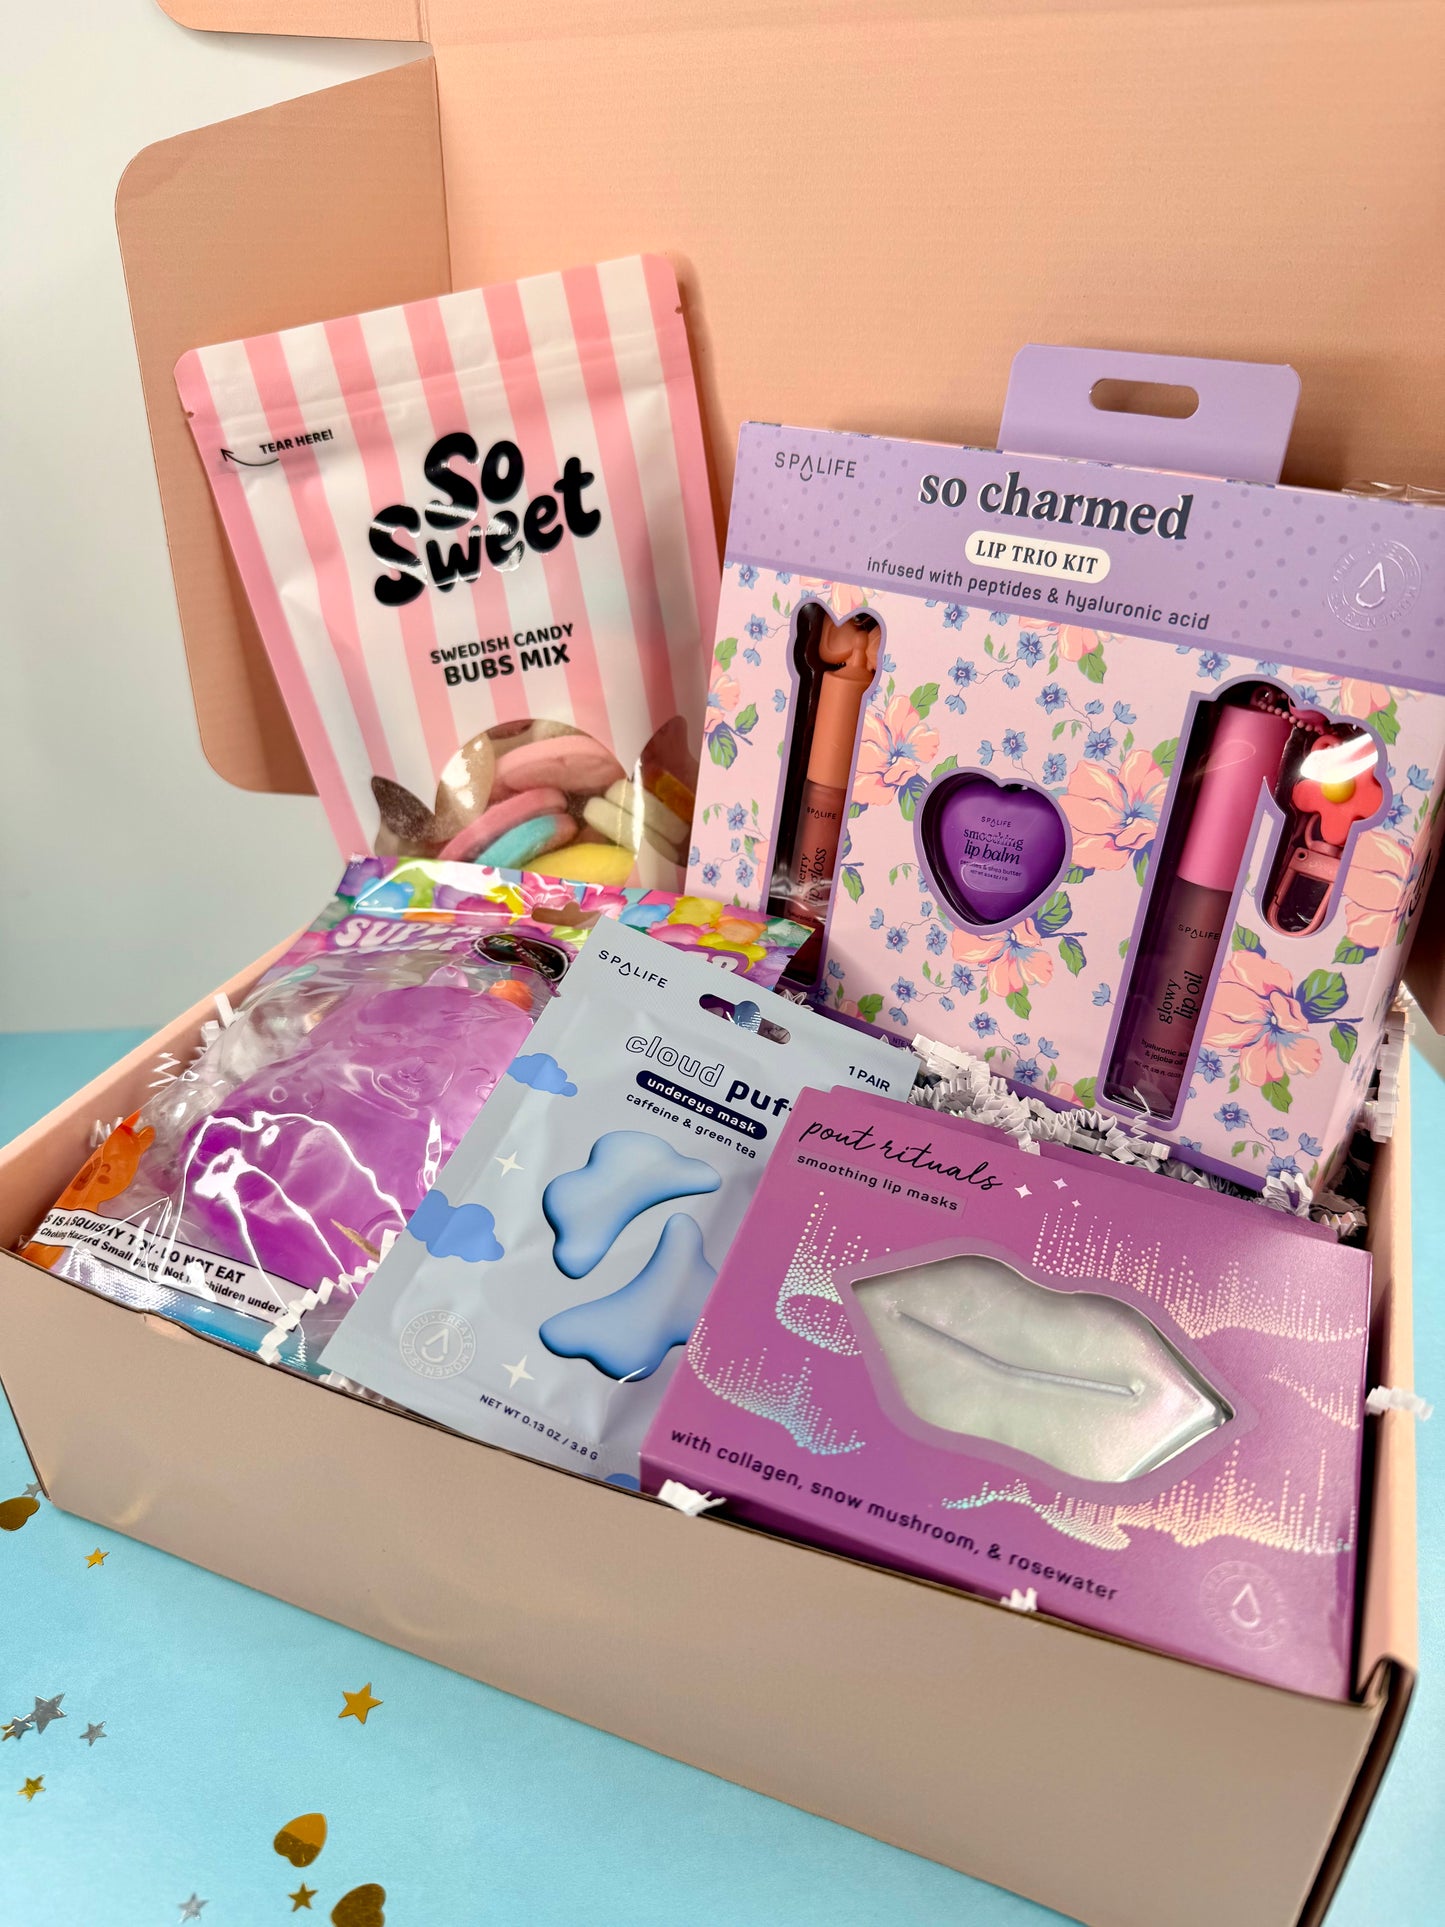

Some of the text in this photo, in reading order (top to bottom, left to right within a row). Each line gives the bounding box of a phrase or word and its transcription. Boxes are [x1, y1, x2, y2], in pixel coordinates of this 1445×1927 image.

[259, 429, 334, 454] TEAR HERE!
[918, 471, 1194, 540] so charmed
[975, 539, 1099, 574] LIP TRIO KIT
[867, 557, 1210, 631] infused with peptides & hyaluronic acid
[430, 623, 574, 664] SWEDISH CANDY
[444, 643, 571, 687] BUBS MIX
[964, 839, 1020, 865] lip balm
[1157, 979, 1181, 1025] glowy
[1174, 970, 1204, 1020] lip oil
[625, 1034, 793, 1117] cloud puf
[848, 1065, 891, 1093] 1 PAIR
[626, 1092, 757, 1159] caffeine & green tea
[646, 1077, 757, 1134] undereye mask
[796, 1154, 958, 1211] smoothing lip masks
[798, 1121, 1003, 1191] pout rituals
[52, 1215, 66, 1227] IS
[215, 1266, 246, 1284] EAT
[101, 1241, 134, 1261] Small
[164, 1266, 184, 1281] Not
[247, 1295, 282, 1315] under
[480, 1394, 502, 1409] NET
[504, 1405, 521, 1419] WT
[522, 1415, 545, 1432] 0.13
[546, 1428, 562, 1442] OZ
[570, 1441, 588, 1456] 3.8
[589, 1451, 599, 1461] G
[671, 1429, 1119, 1601] with collagen, snow mushroom, & rosewater
